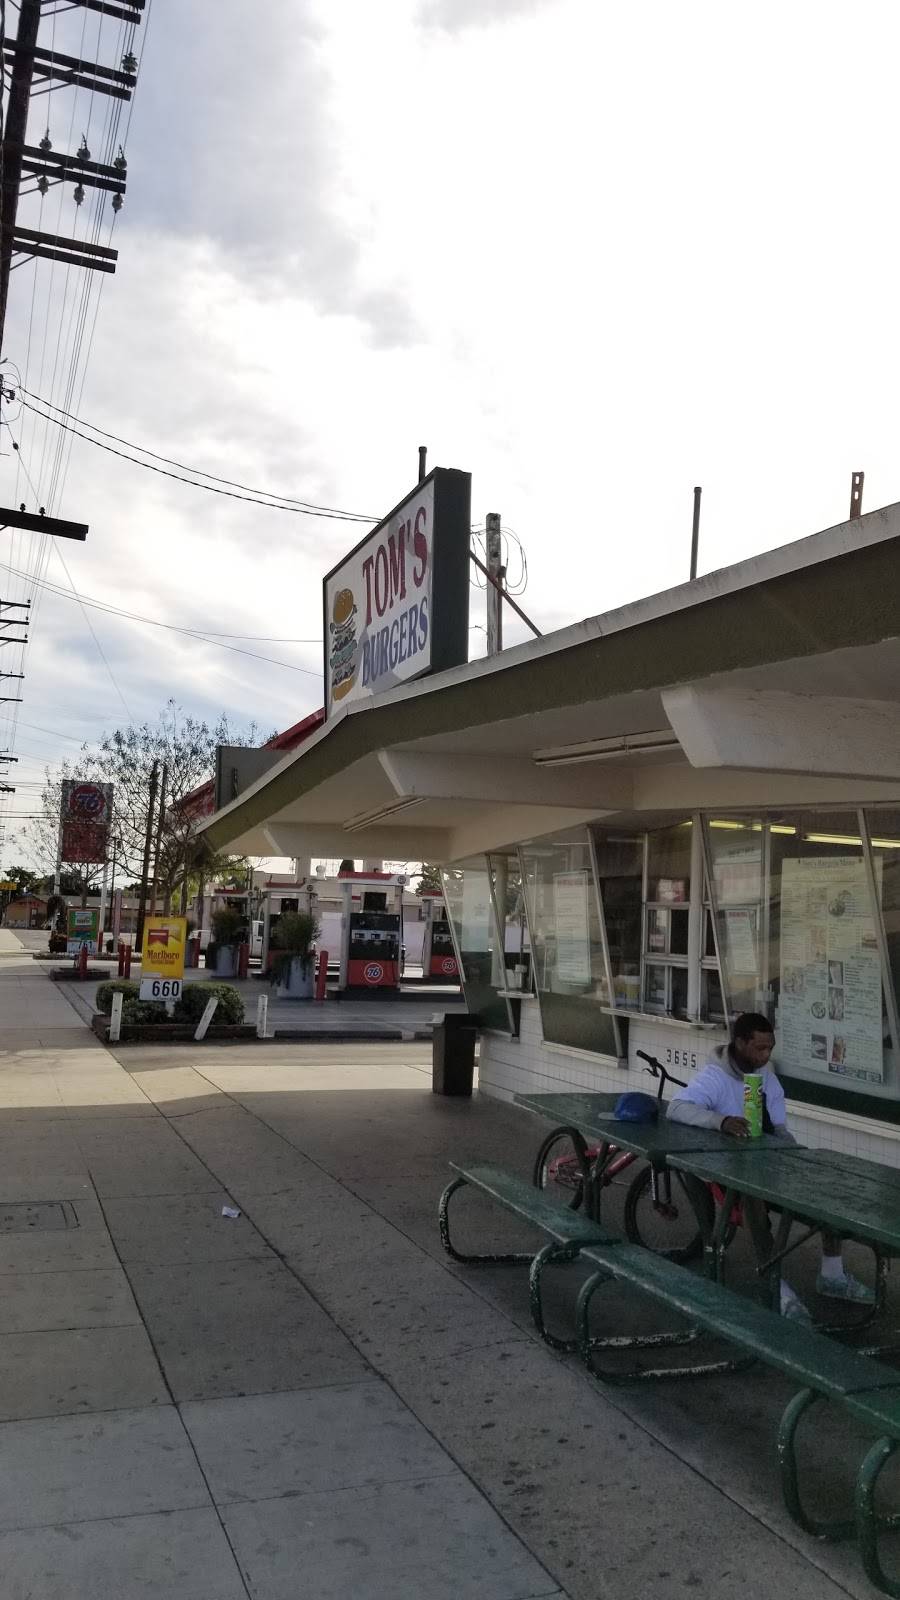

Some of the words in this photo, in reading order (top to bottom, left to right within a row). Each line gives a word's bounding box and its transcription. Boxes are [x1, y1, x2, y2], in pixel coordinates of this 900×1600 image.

[362, 506, 428, 626] TOM'S
[361, 596, 428, 688] BURGERS
[147, 949, 180, 960] Marlboro
[367, 966, 381, 978] 76
[152, 980, 180, 997] 660
[666, 1048, 697, 1068] 3655
